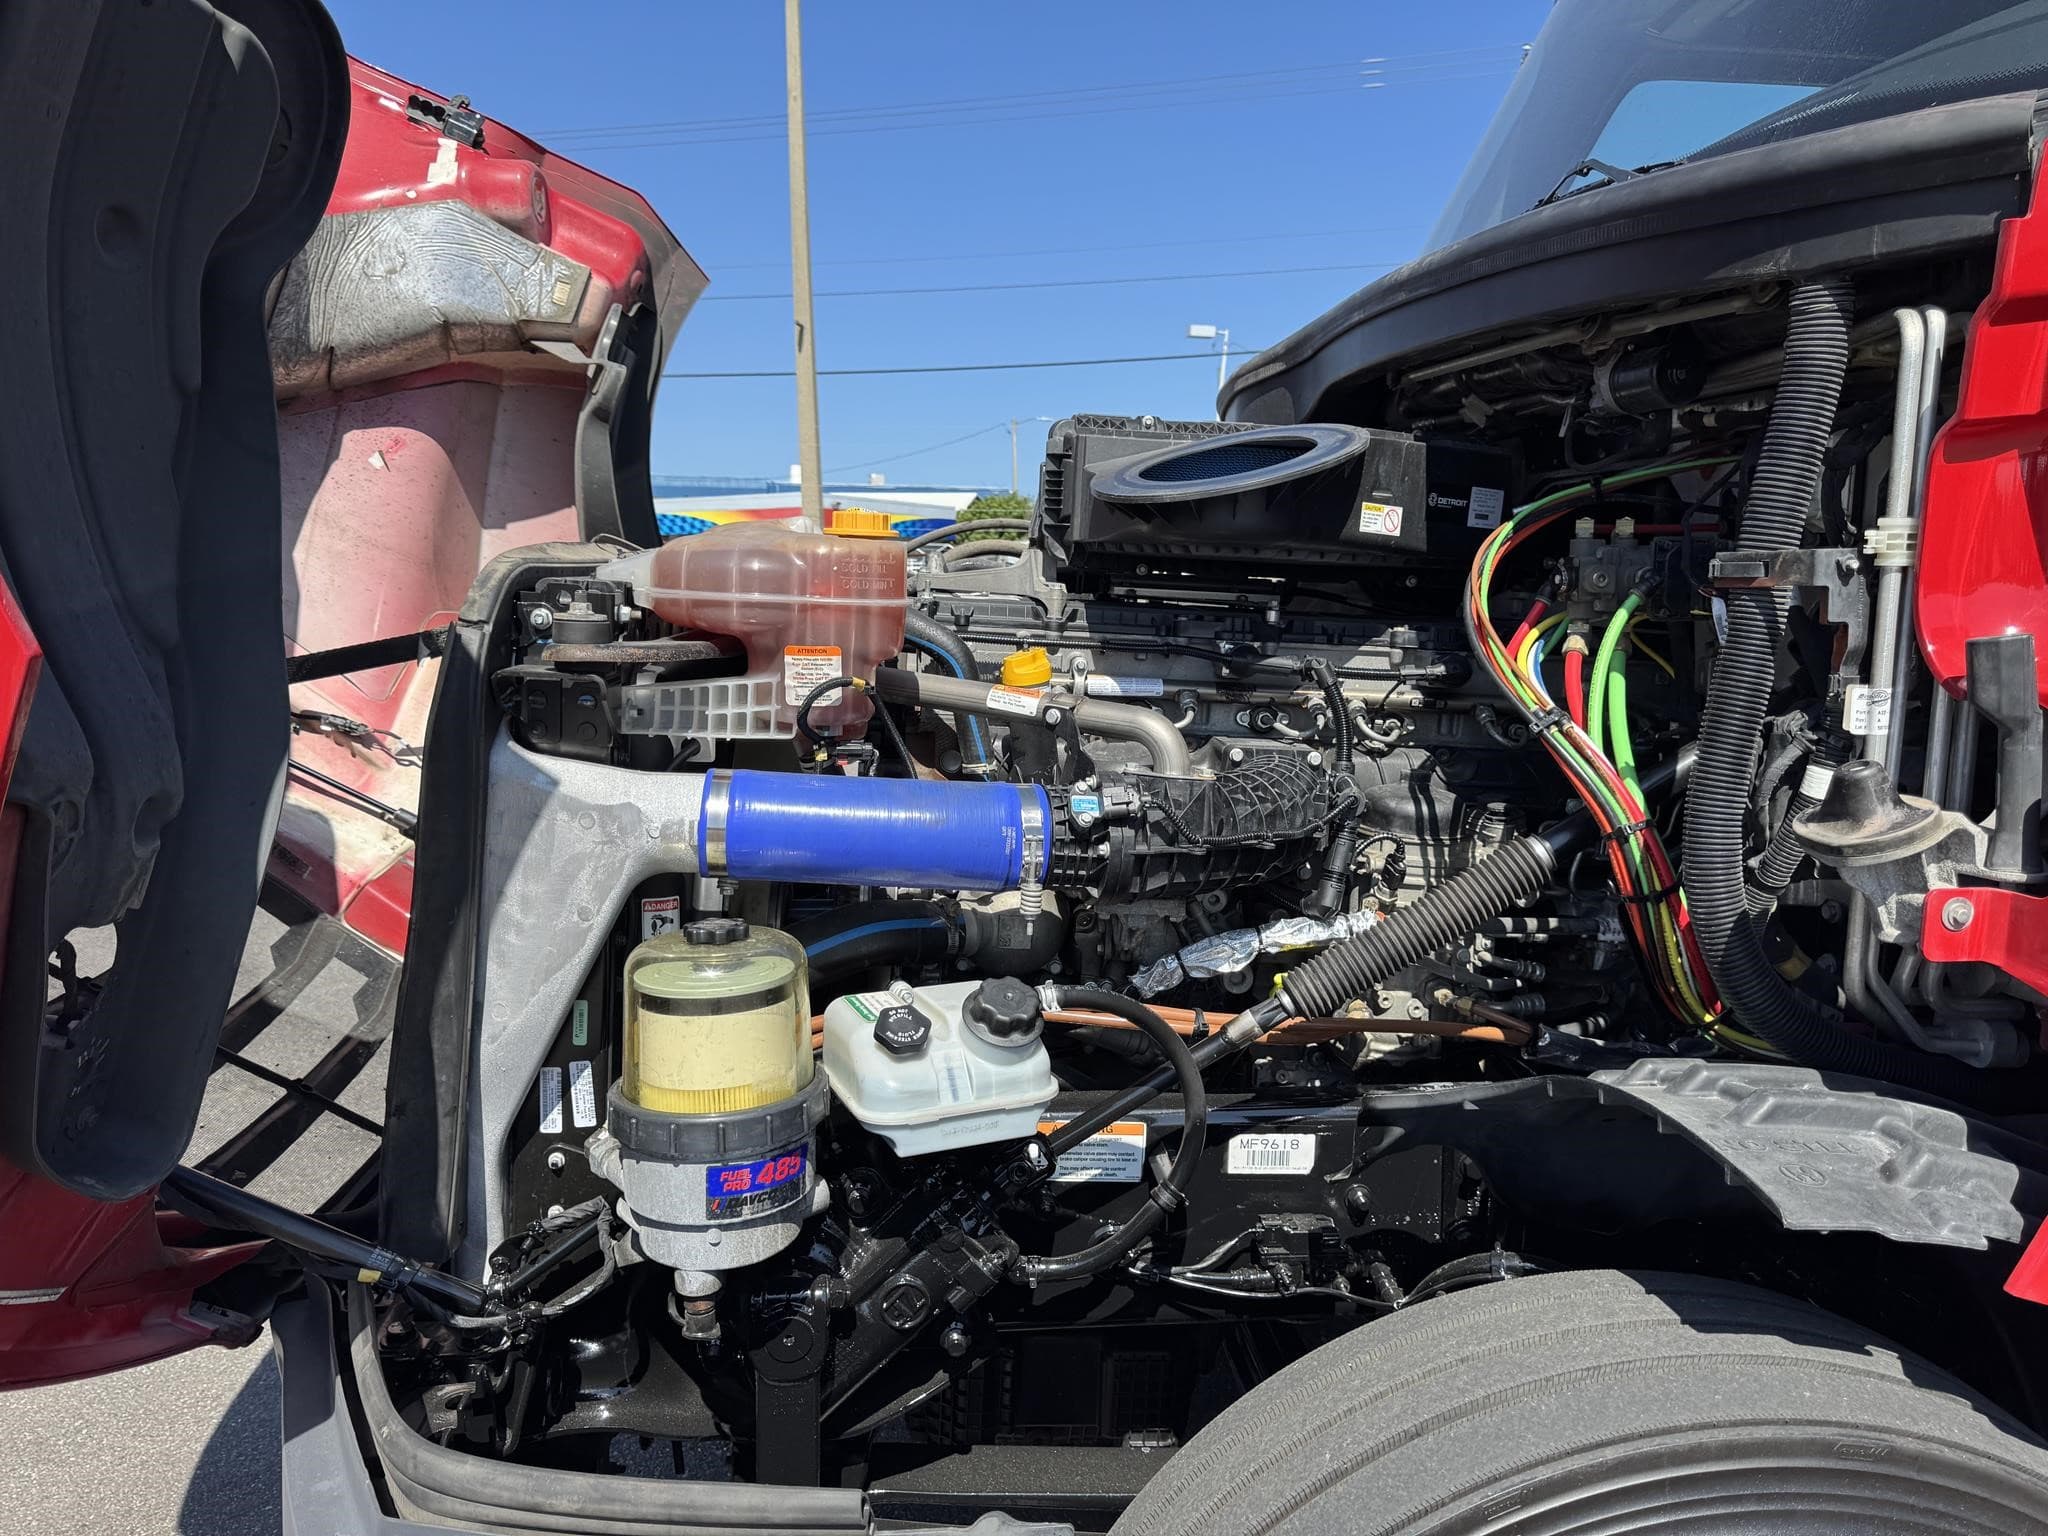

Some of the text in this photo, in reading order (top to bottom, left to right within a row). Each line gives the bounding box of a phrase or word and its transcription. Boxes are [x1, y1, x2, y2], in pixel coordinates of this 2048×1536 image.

[1438, 497, 1468, 507] DETROIT
[651, 901, 678, 910] DANGER
[1239, 1138, 1300, 1150] MF9618
[720, 1168, 753, 1182] FUEL
[755, 1152, 801, 1185] 485
[723, 1178, 752, 1193] PRO
